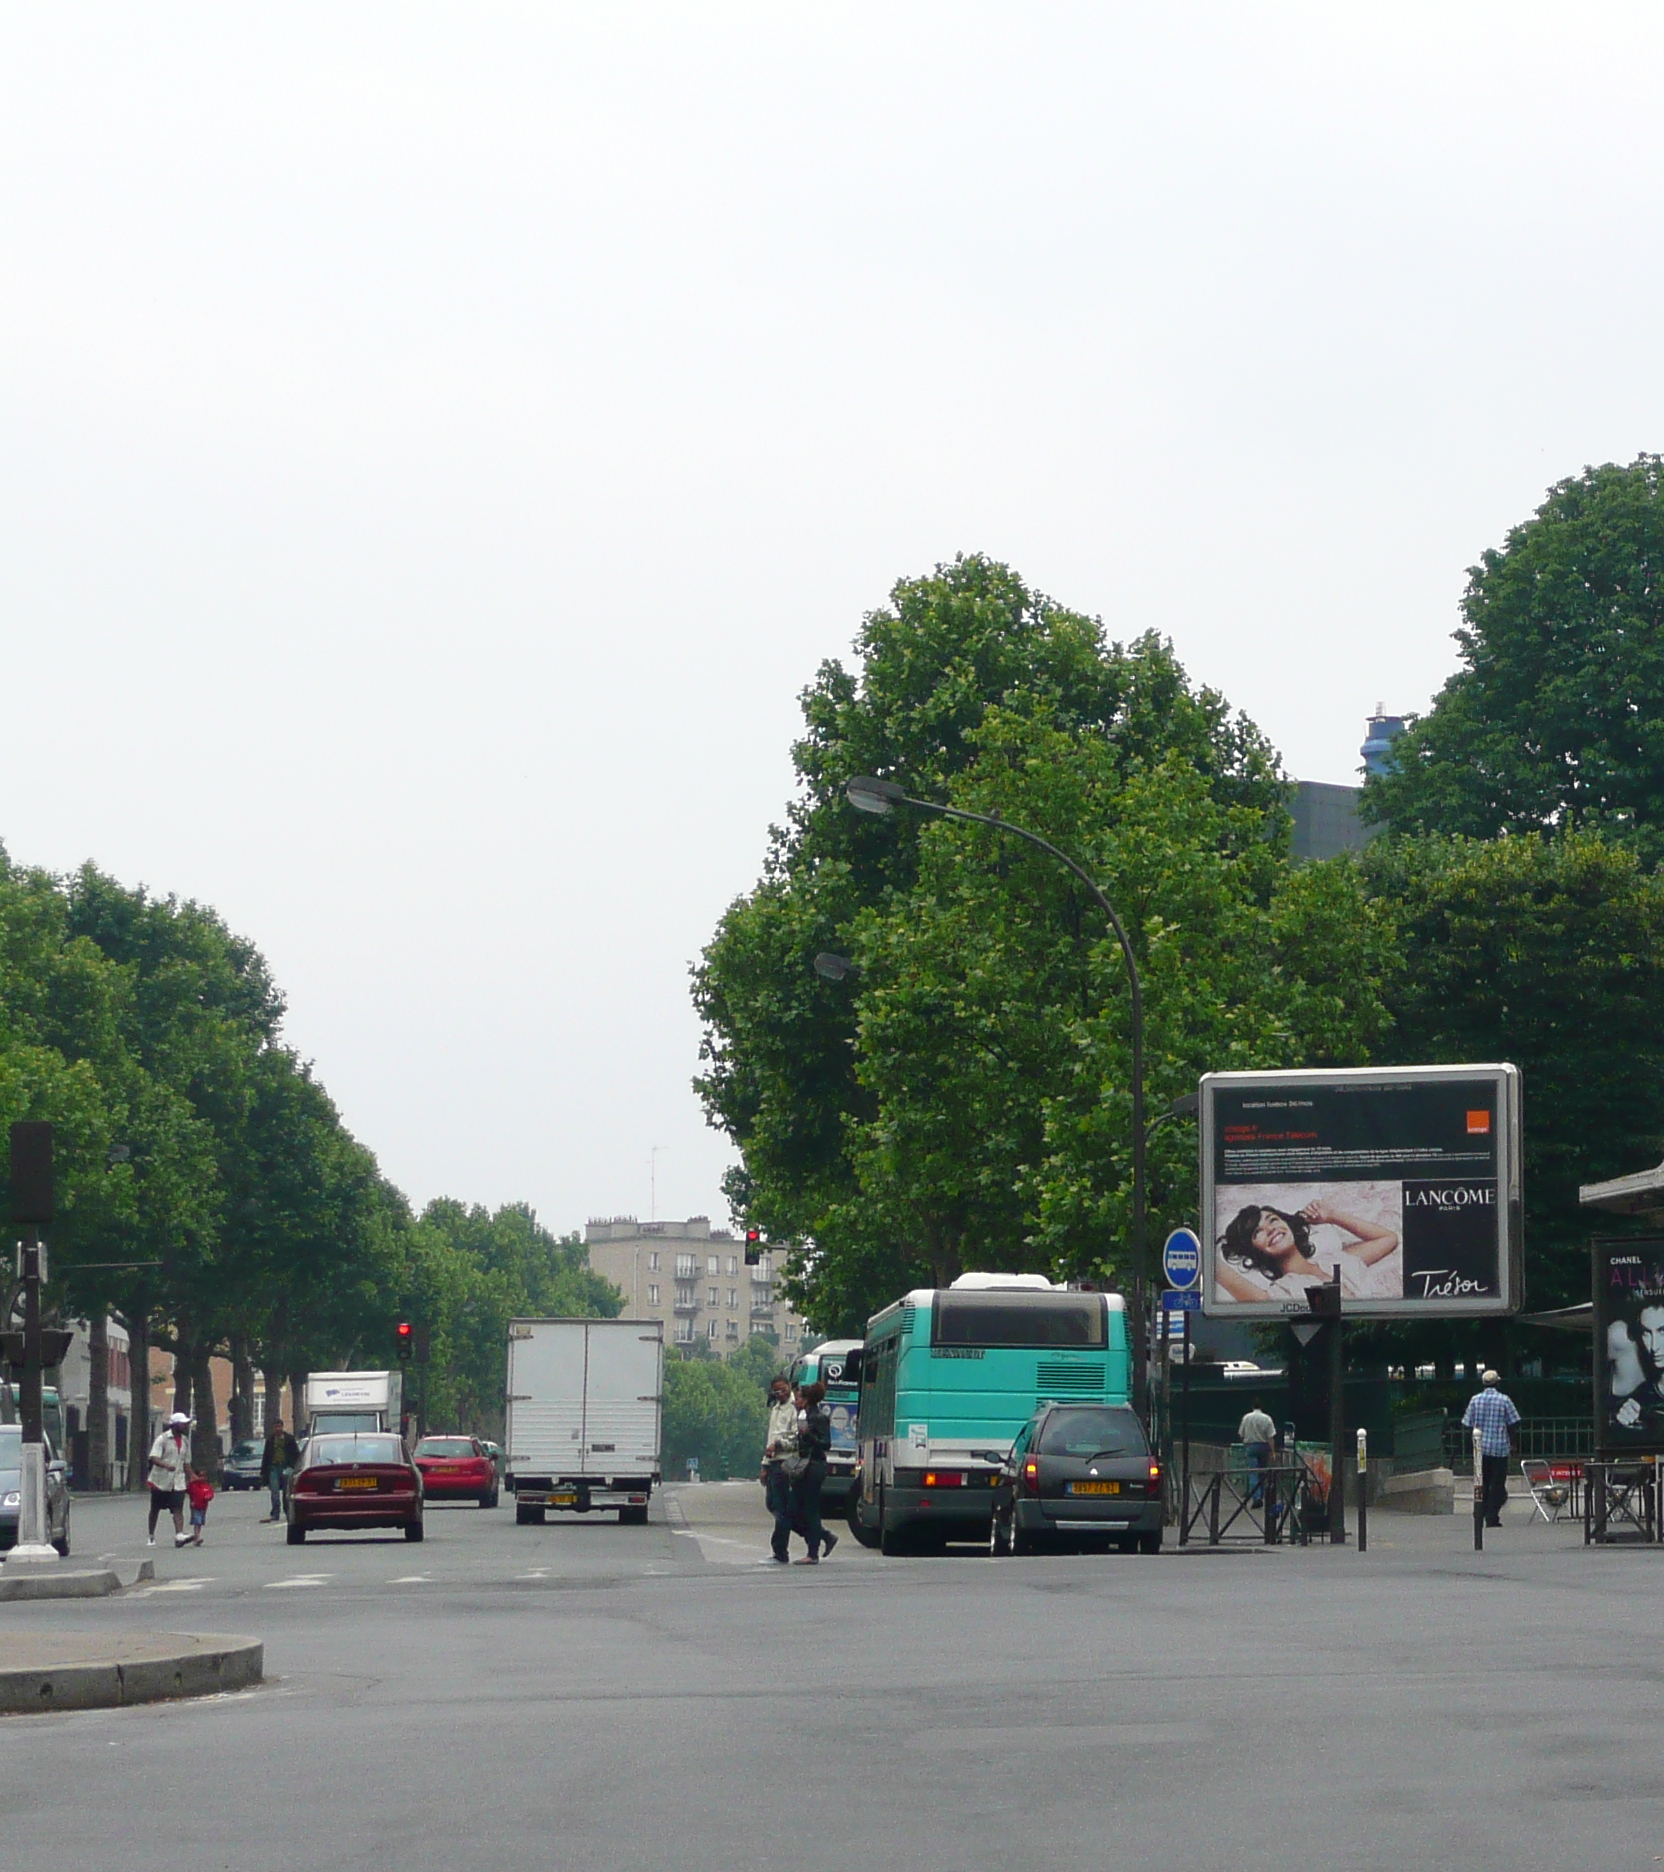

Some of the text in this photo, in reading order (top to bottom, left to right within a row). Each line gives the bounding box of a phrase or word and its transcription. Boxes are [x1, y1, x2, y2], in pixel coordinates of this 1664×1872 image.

[1405, 1187, 1496, 1206] LANCÔME
[1610, 1256, 1642, 1265] CHANEL
[1411, 1269, 1489, 1298] Trésor
[1280, 1303, 1312, 1313] JCDec
